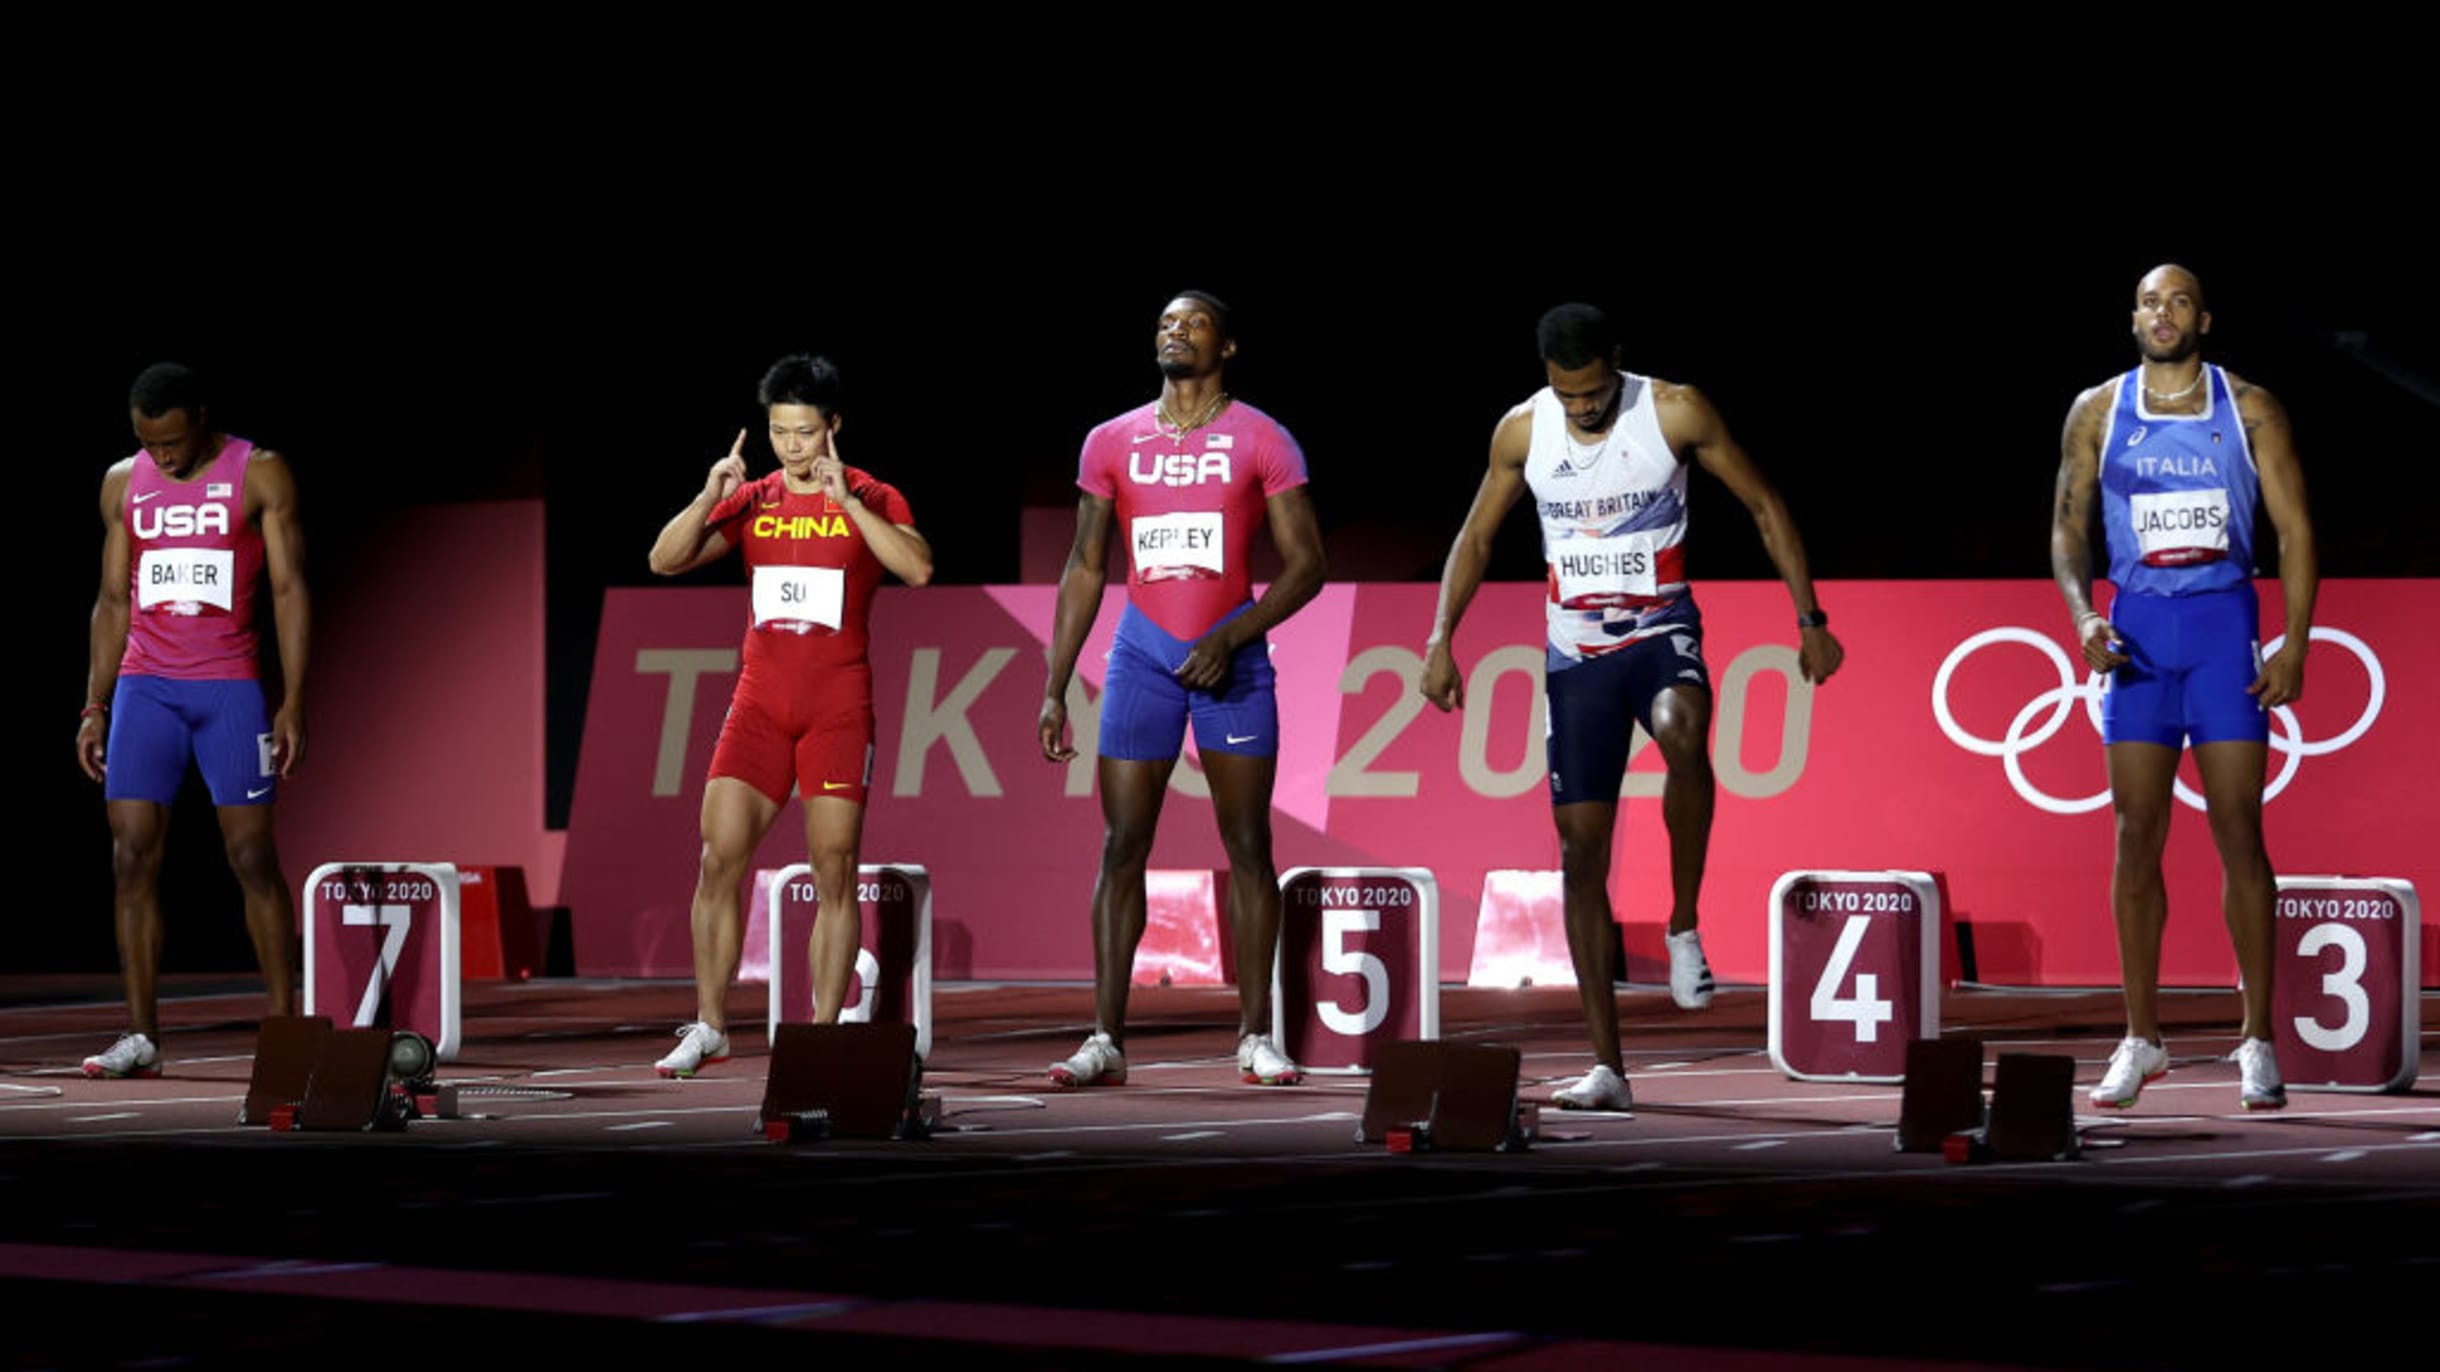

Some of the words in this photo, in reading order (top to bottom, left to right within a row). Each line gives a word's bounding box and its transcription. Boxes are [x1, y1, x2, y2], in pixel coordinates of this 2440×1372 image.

[1129, 452, 1232, 487] USA
[2136, 456, 2218, 477] ITALIA
[133, 502, 229, 539] USA
[753, 515, 850, 539] CHINA
[2138, 506, 2222, 533] JACOBS
[151, 564, 218, 586] BAKER
[1560, 552, 1646, 577] HUGHES
[780, 581, 807, 603] SU
[1325, 644, 1814, 799] 200
[387, 882, 433, 901] 2020
[857, 883, 905, 902] 2020
[1296, 887, 1360, 906] TOKYO
[1363, 887, 1412, 906] 2020
[1795, 892, 1859, 912] TOKYO
[1862, 892, 1912, 912] 2020
[2343, 899, 2394, 919] 2020
[342, 904, 411, 1028] 7
[1316, 910, 1390, 1036] 5
[1810, 915, 1893, 1042] 4
[2294, 922, 2370, 1052] 3
